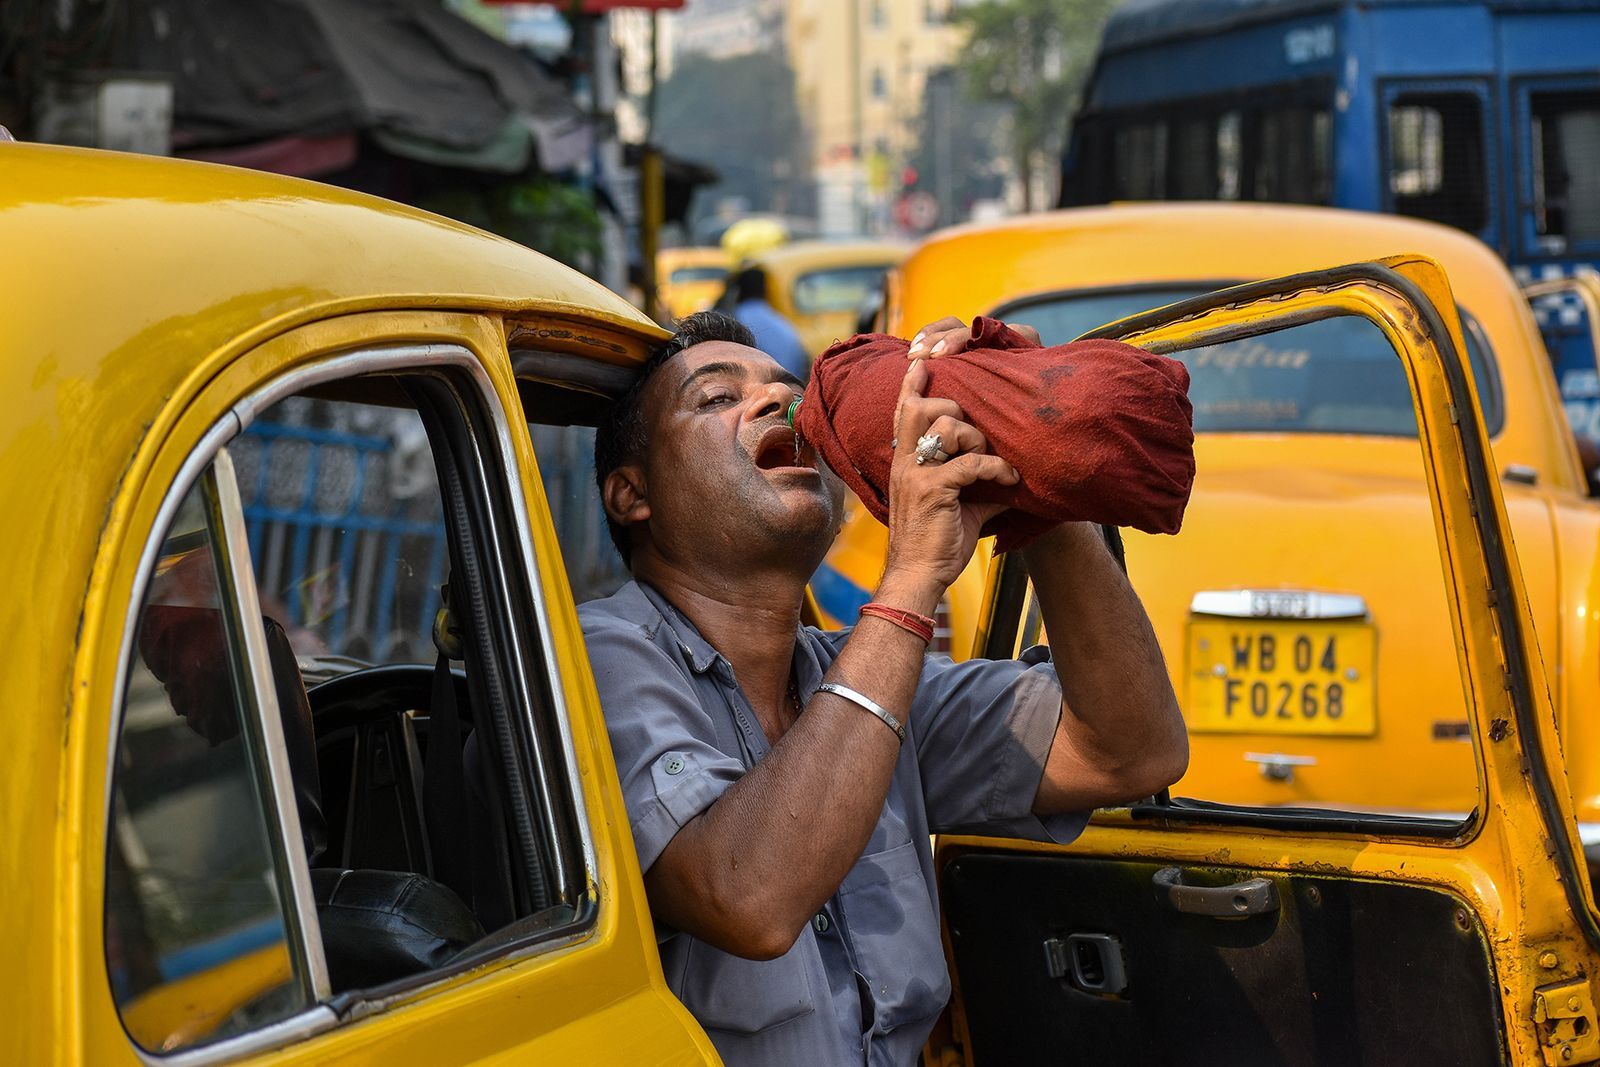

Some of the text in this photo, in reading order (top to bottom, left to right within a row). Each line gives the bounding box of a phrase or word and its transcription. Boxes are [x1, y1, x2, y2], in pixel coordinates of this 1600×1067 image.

[1231, 634, 1337, 673] WB 04
[1224, 679, 1343, 719] F0268
